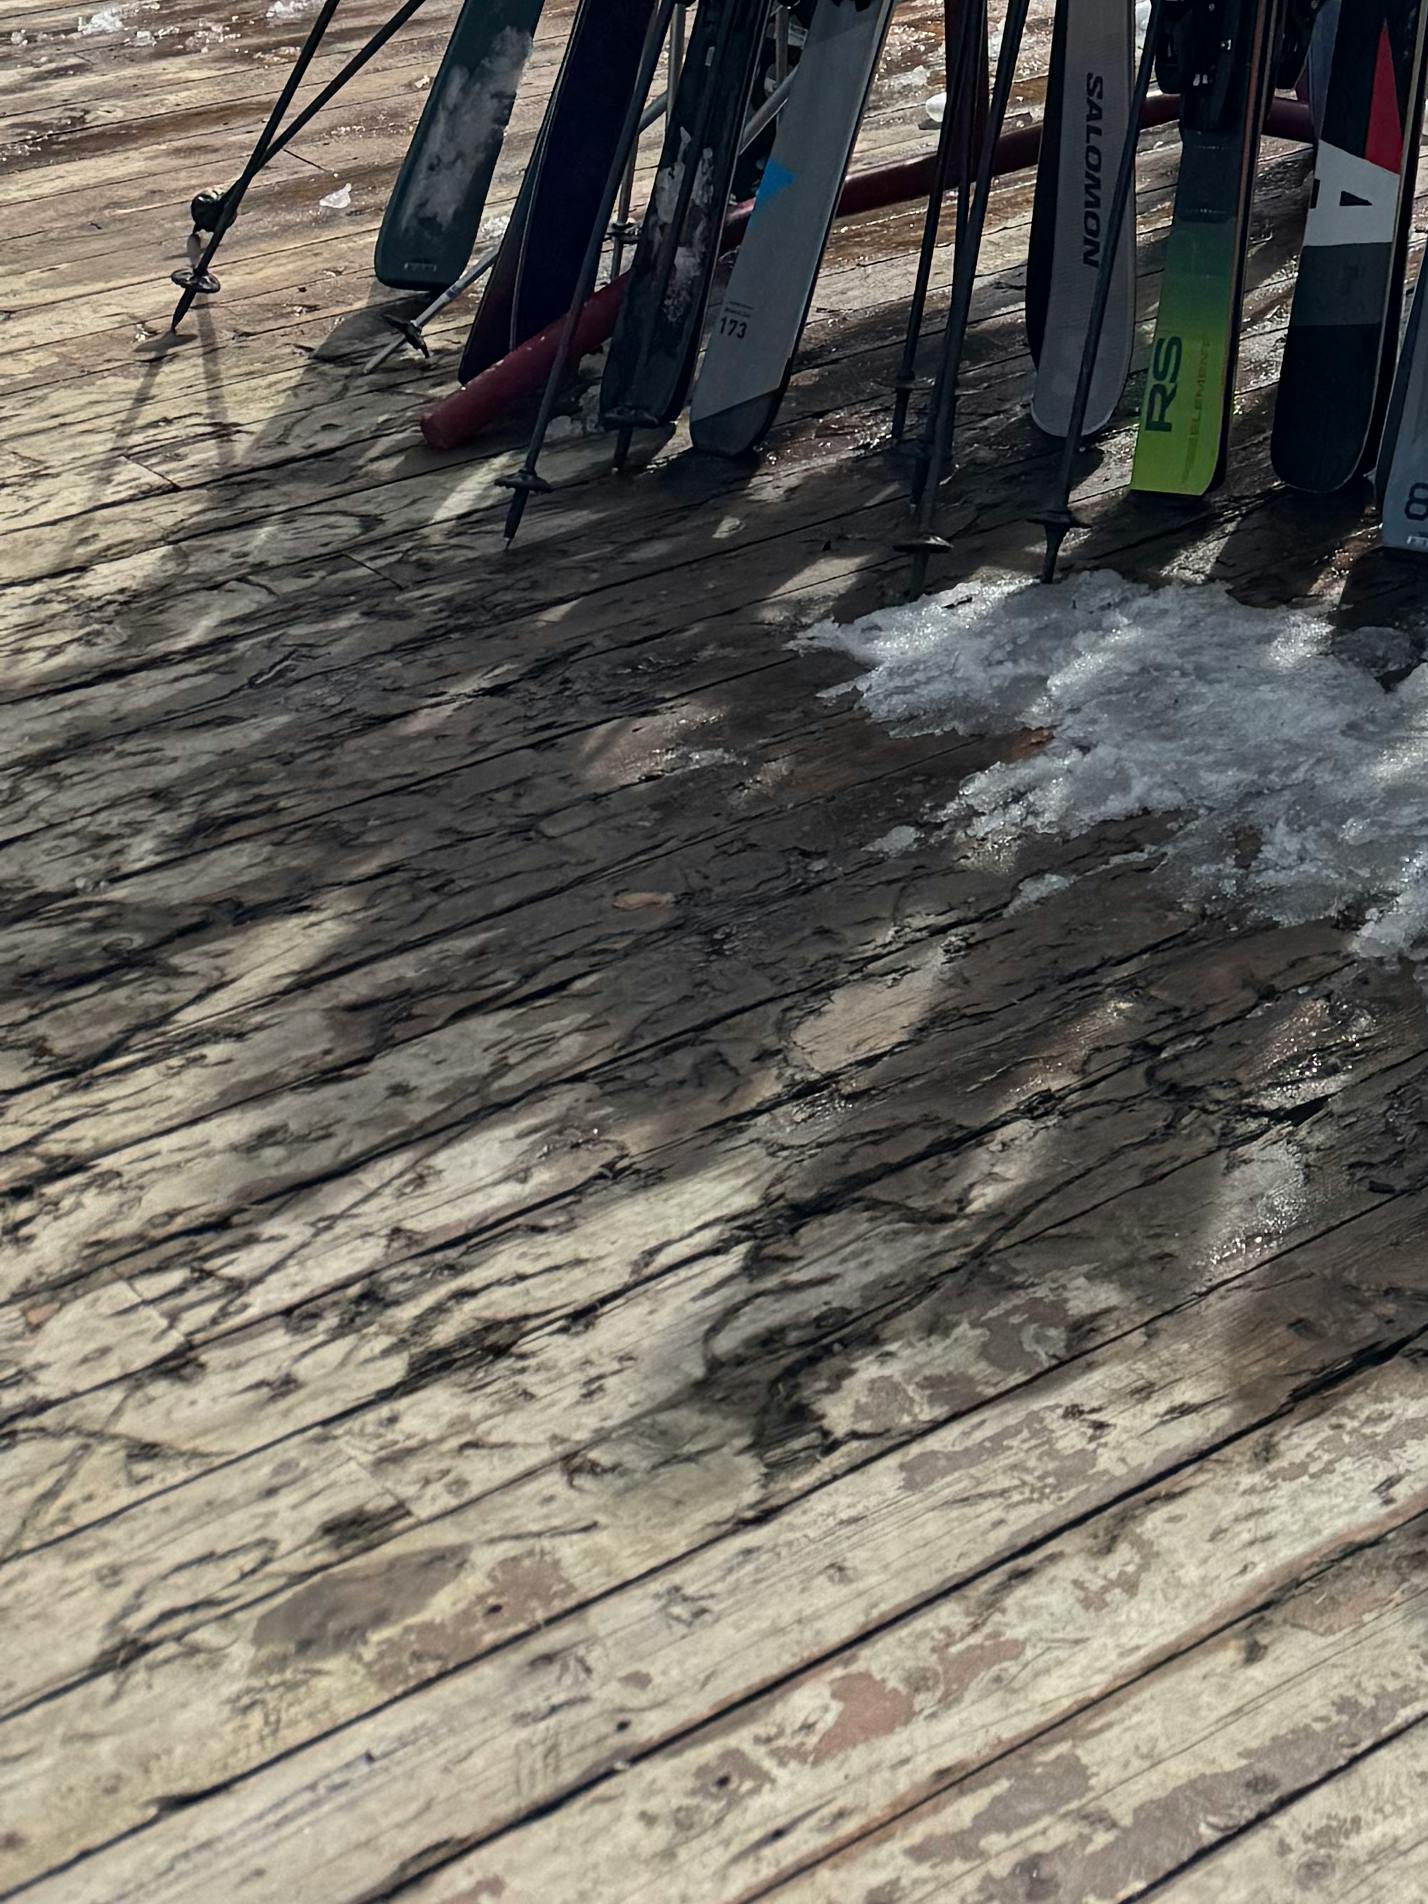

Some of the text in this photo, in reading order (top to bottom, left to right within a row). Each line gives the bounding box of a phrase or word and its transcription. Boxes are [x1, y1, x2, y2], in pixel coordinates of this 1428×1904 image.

[1082, 72, 1104, 268] SALOMON
[719, 315, 748, 340] 173
[1145, 335, 1183, 433] RS
